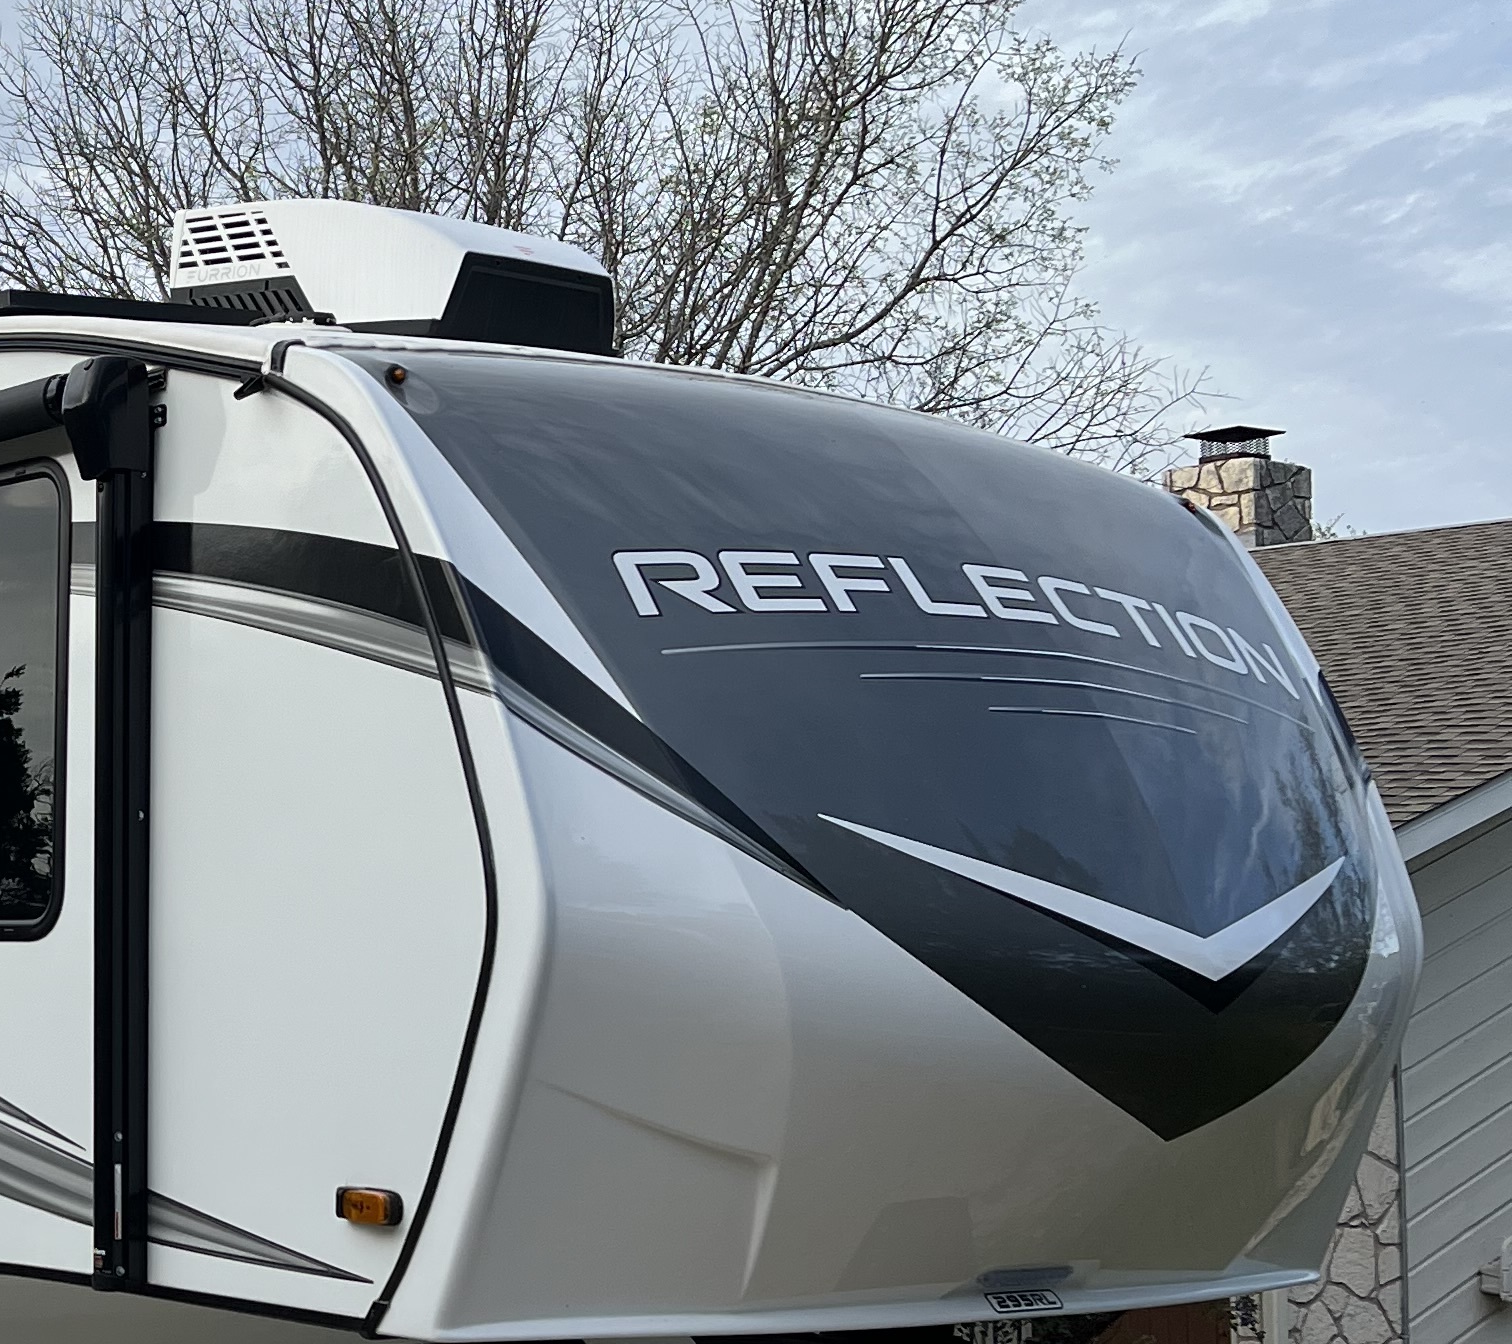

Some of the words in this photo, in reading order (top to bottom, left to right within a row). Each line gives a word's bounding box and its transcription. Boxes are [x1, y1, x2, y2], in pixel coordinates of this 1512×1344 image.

[186, 262, 262, 284] FURRION
[611, 549, 1300, 700] REFLECTION
[992, 1292, 1057, 1309] 295RL
